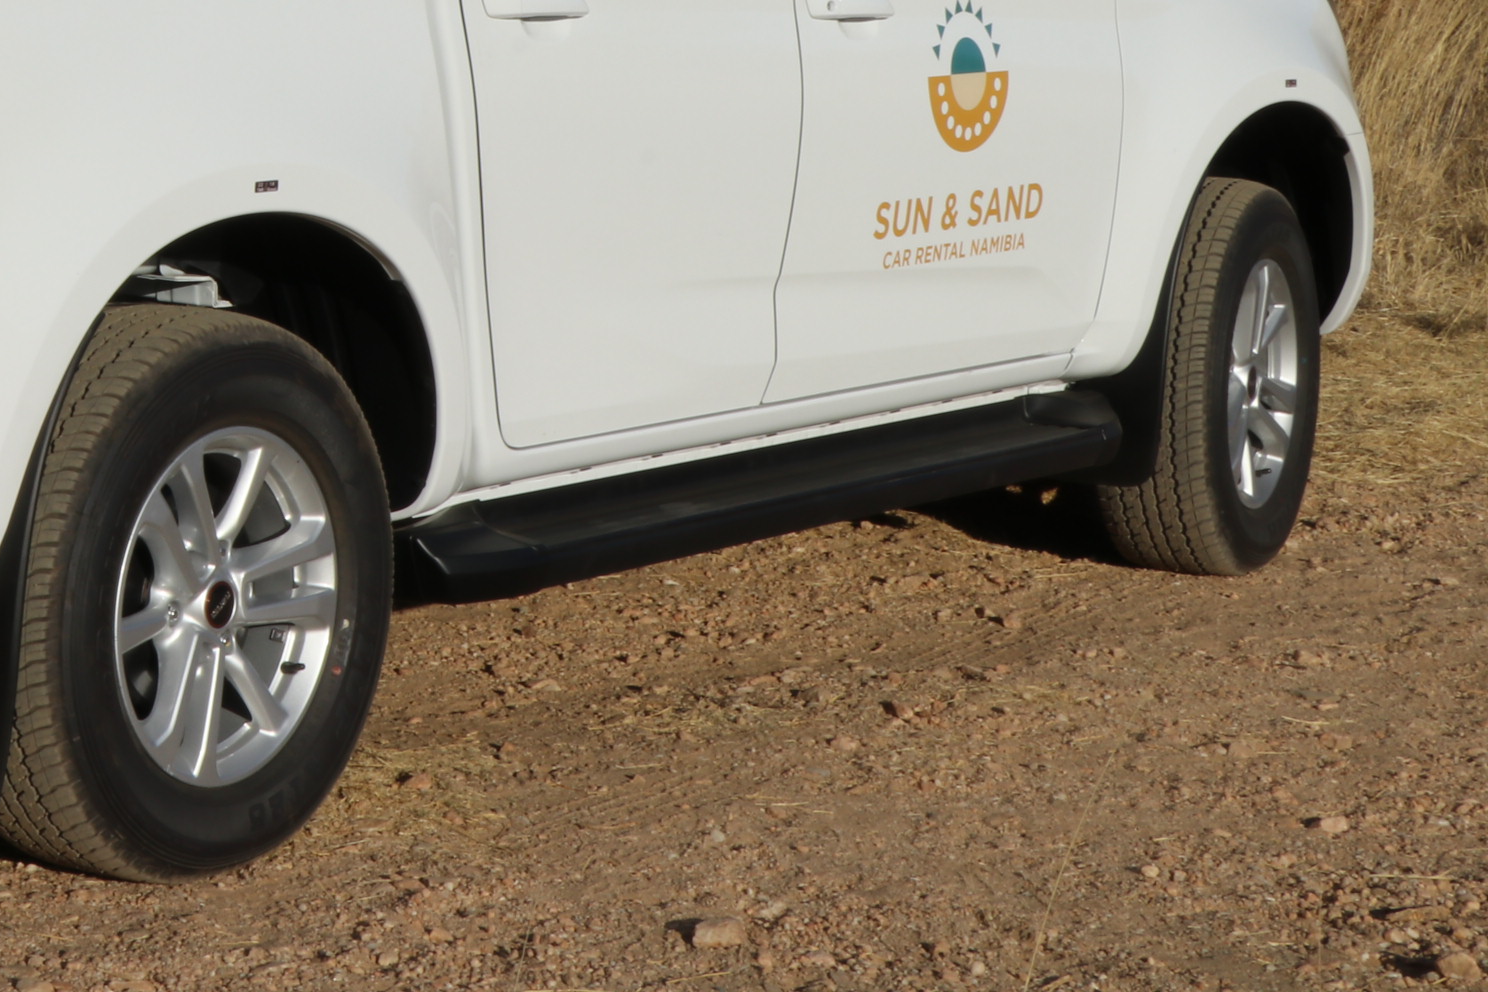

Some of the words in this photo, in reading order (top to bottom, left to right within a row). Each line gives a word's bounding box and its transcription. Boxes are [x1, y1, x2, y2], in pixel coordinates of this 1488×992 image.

[873, 196, 933, 240] SUN
[940, 193, 958, 230] &
[967, 183, 1043, 227] SAND
[882, 249, 911, 269] CAR
[915, 242, 965, 265] RENTAL
[970, 233, 1025, 257] NAMIBIA
